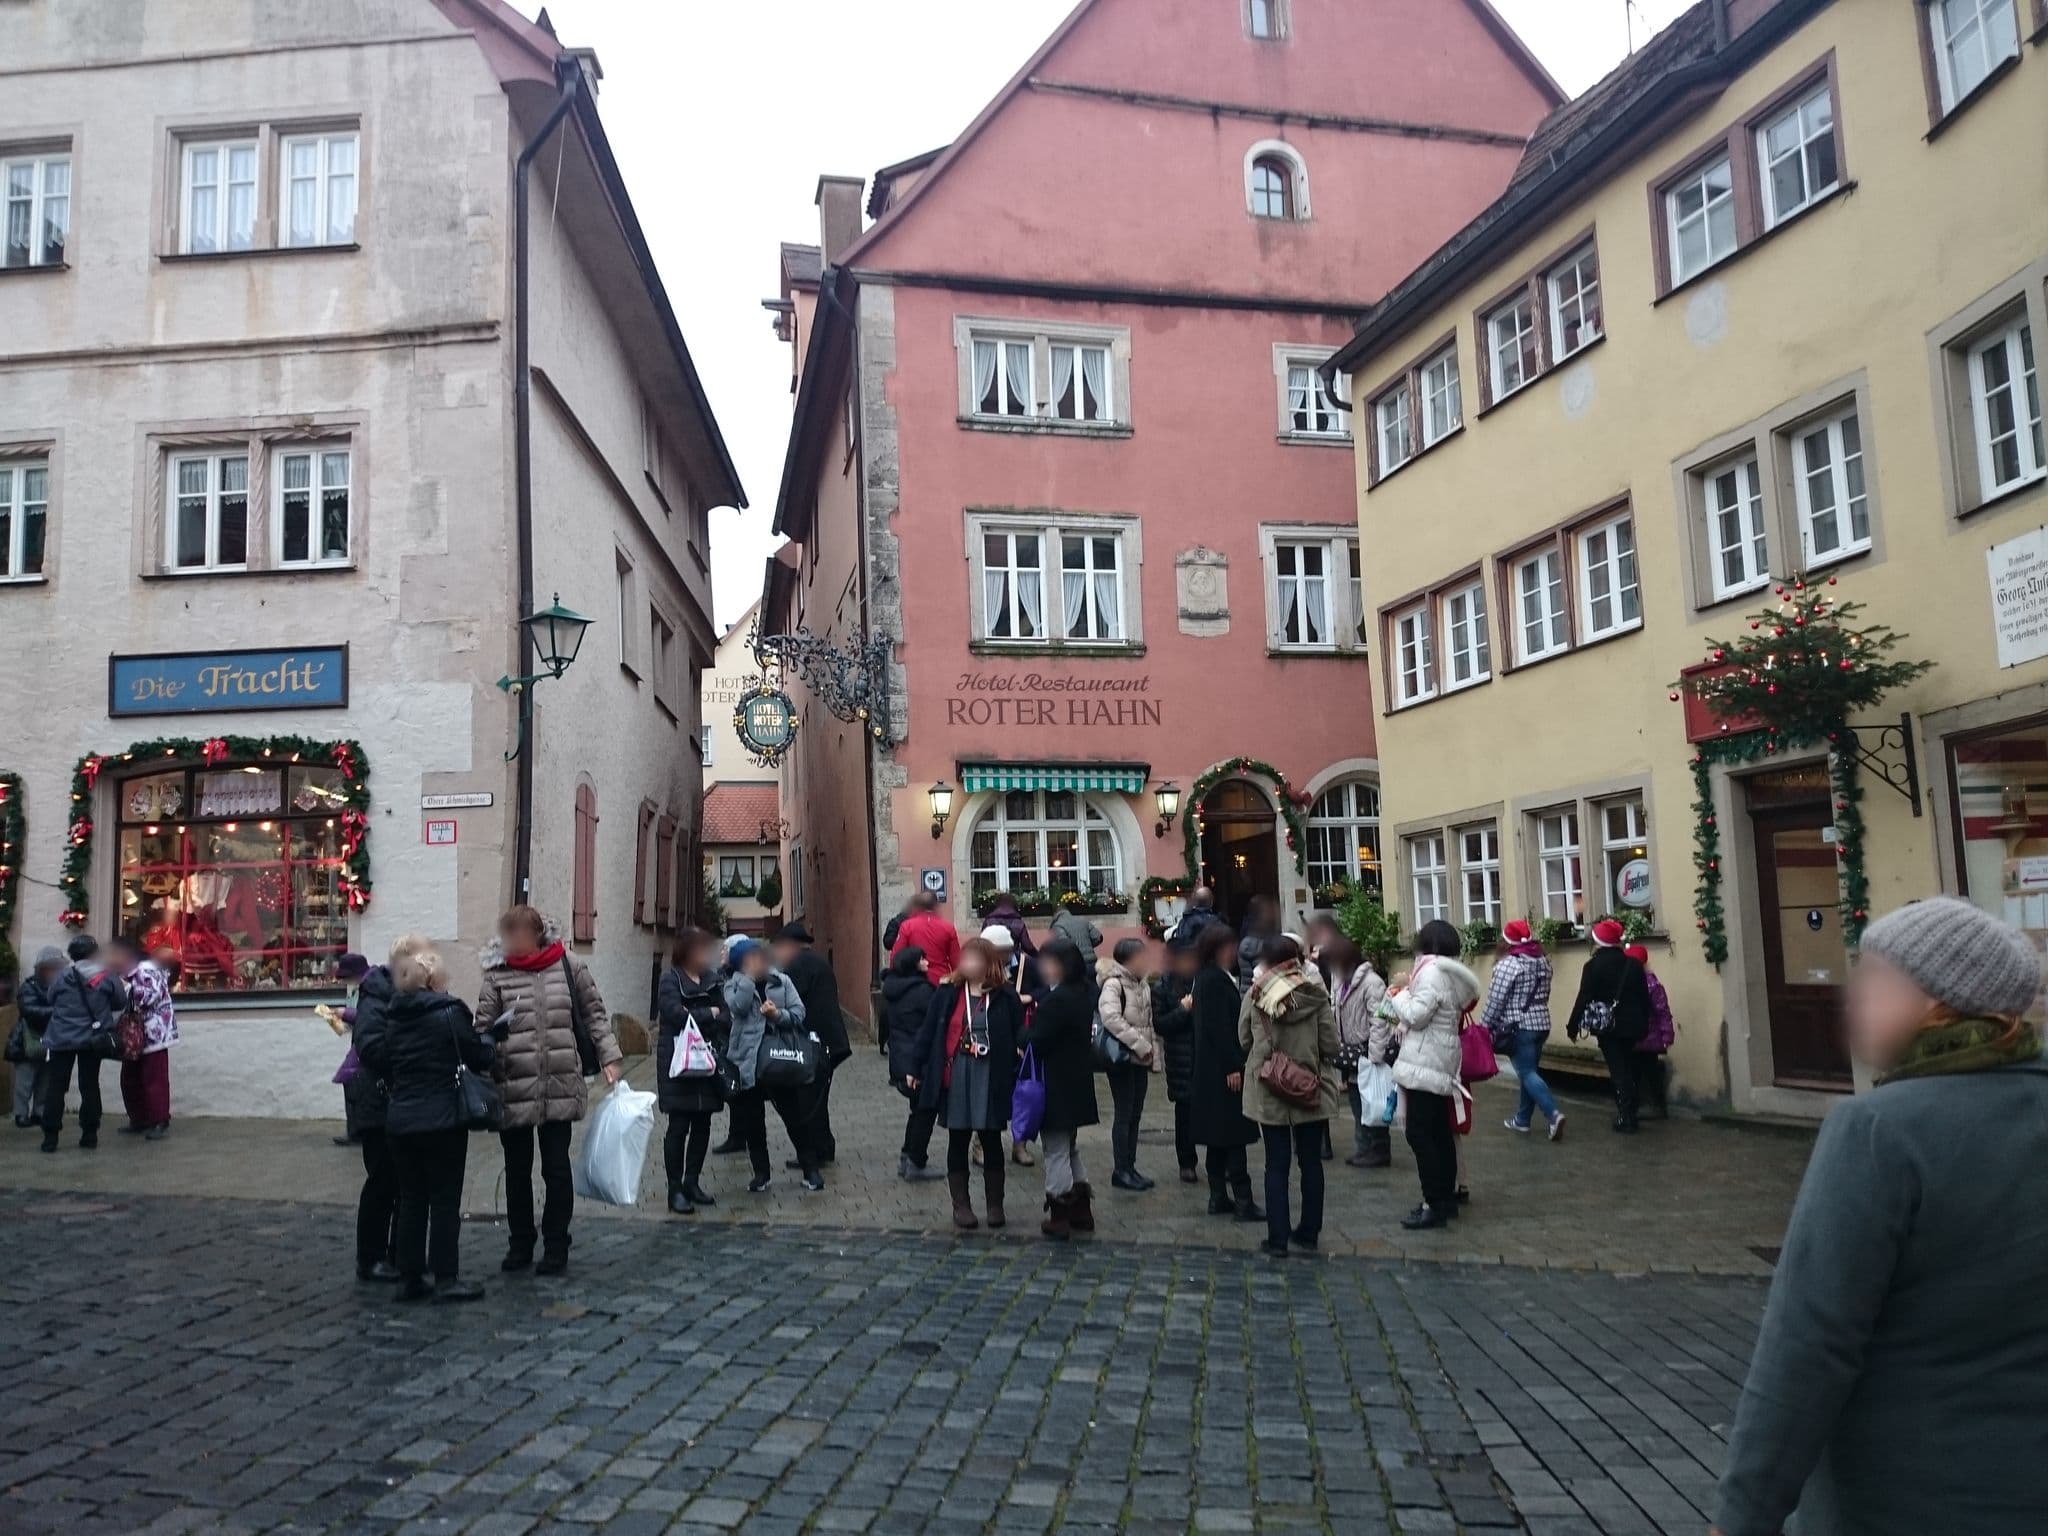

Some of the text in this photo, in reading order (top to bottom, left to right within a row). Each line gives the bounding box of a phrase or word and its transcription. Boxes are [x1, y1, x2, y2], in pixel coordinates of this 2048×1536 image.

[1997, 586, 2027, 605] Georg
[131, 657, 325, 701] Die Tracht
[702, 691, 736, 703] OTER
[753, 703, 782, 715] HOTEL
[946, 698, 1163, 726] ROTER HAHN
[753, 714, 783, 726] ROTER
[754, 726, 784, 737] HAHN
[769, 1047, 796, 1058] Hurley
